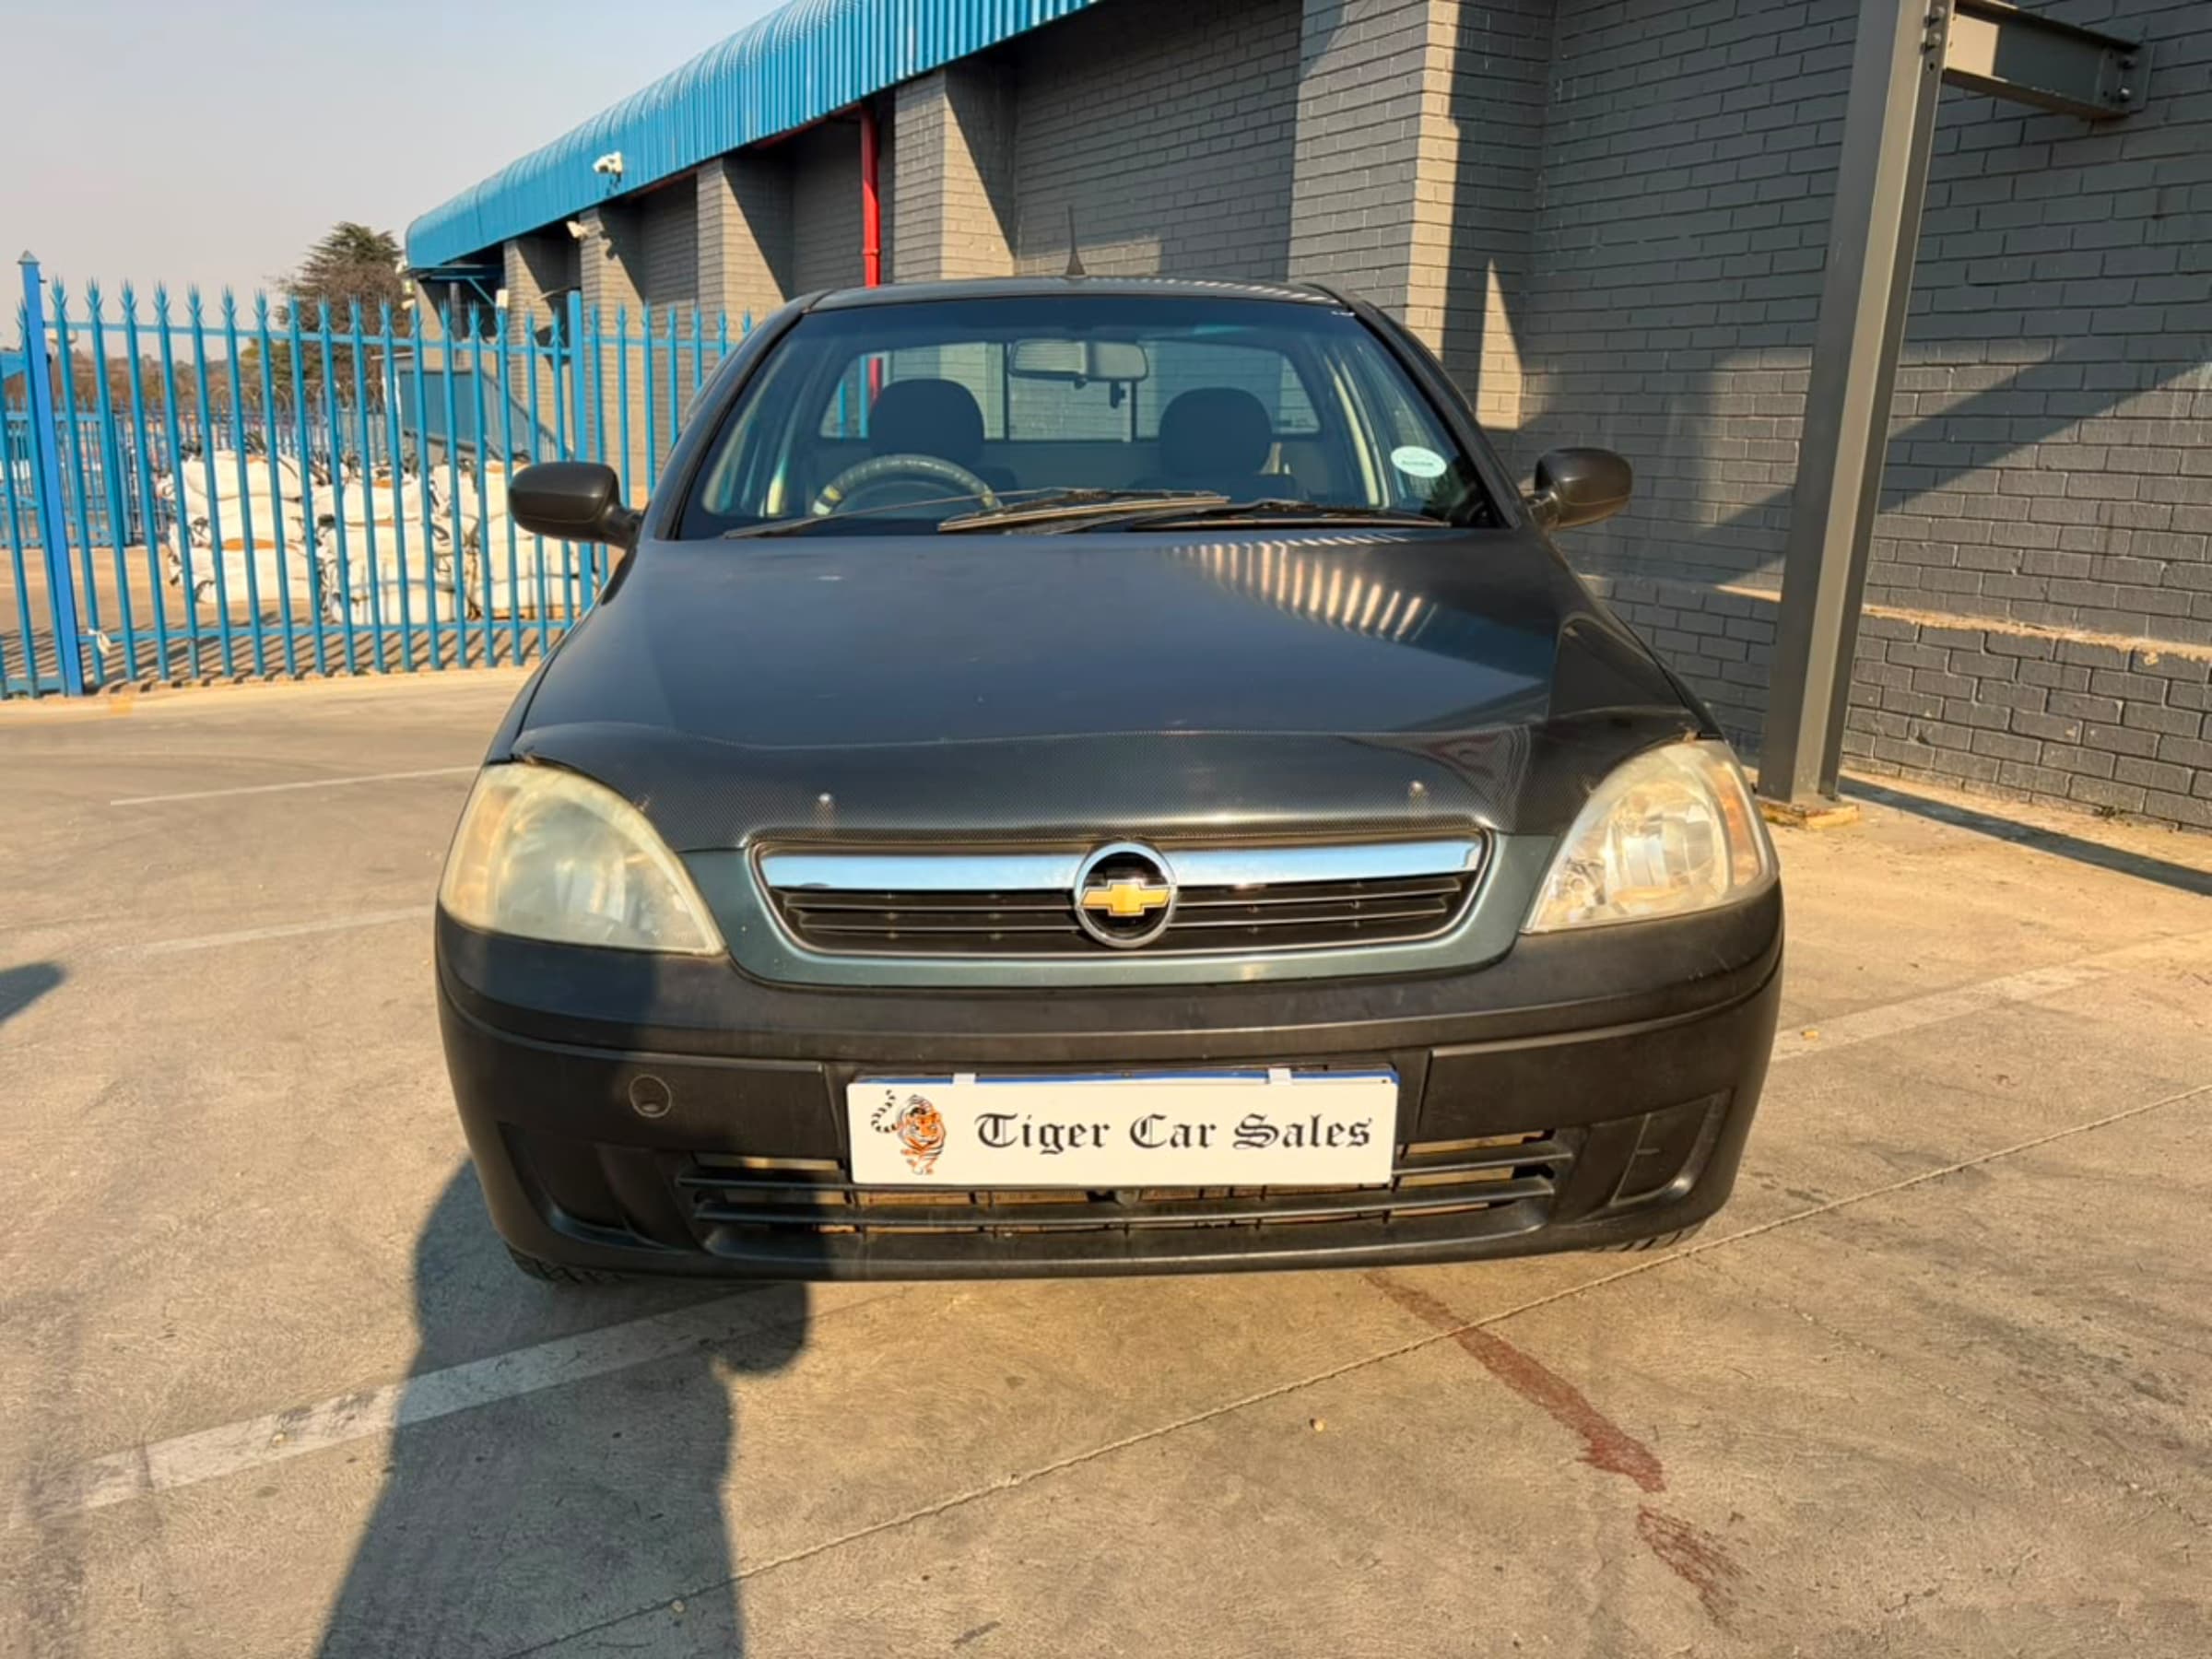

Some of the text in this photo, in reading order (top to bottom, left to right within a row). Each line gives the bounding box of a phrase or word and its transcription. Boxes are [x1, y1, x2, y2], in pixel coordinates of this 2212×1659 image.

[974, 1112, 1372, 1155] Tiger Car Sales
